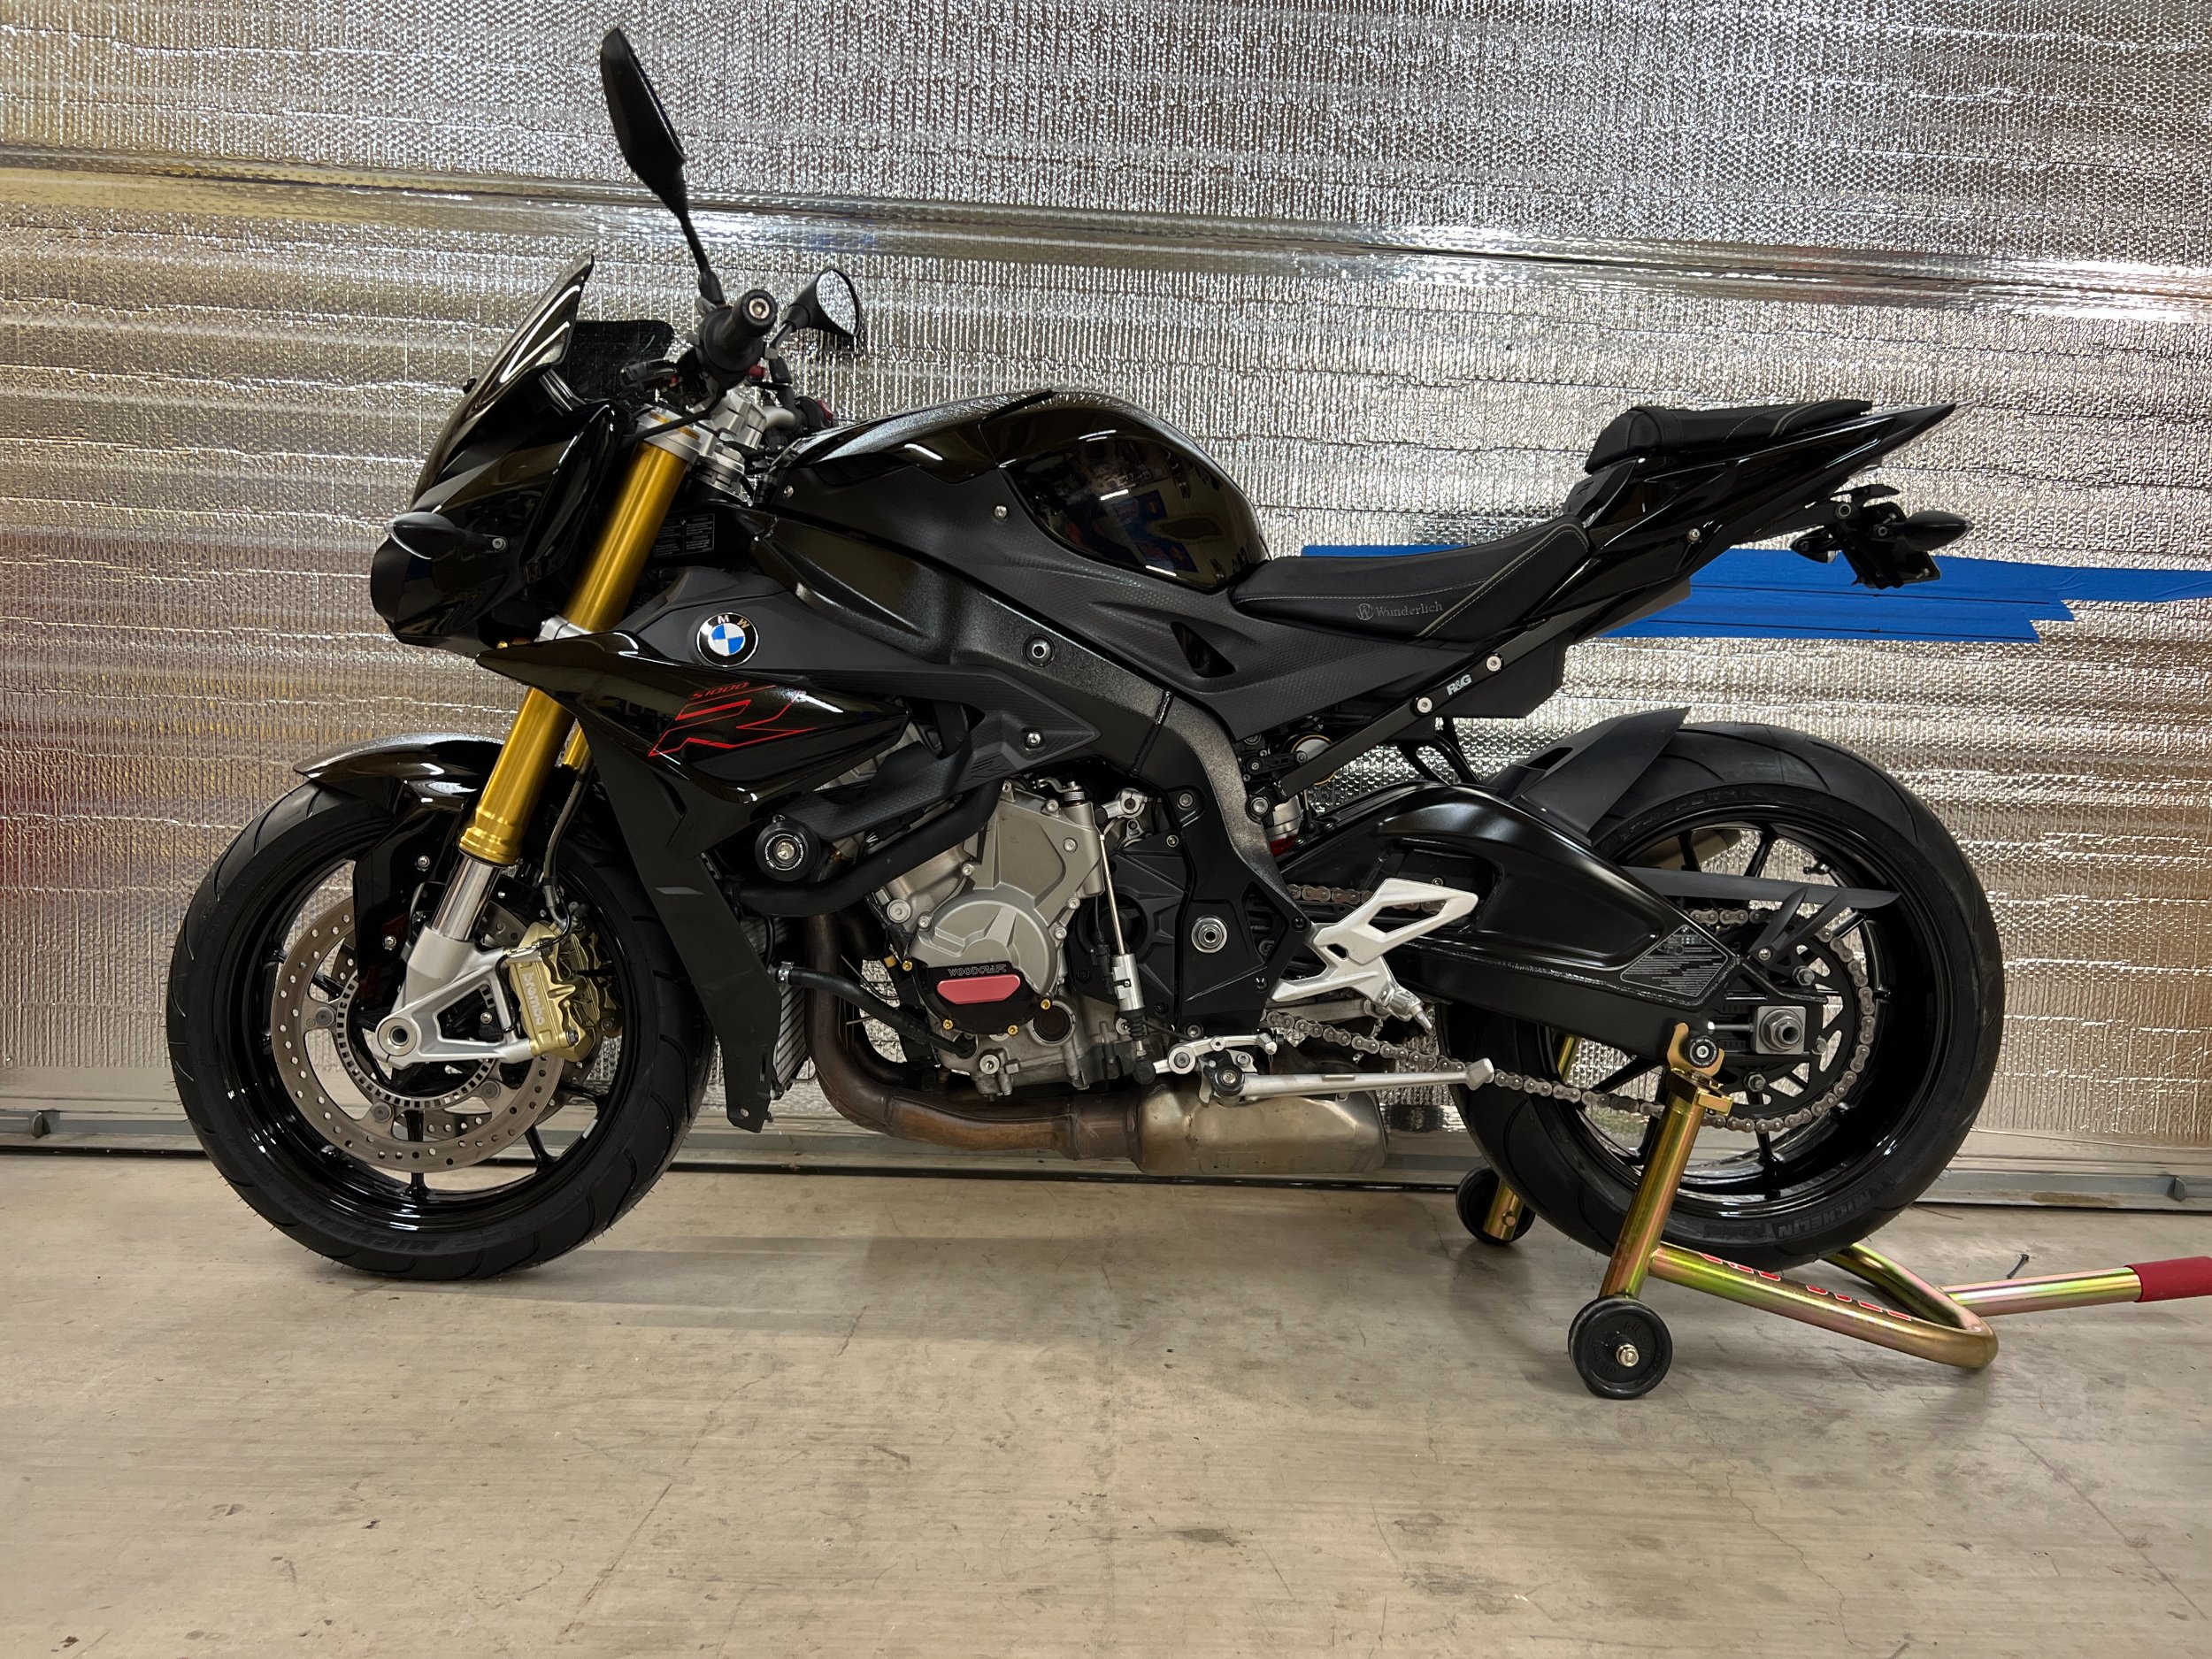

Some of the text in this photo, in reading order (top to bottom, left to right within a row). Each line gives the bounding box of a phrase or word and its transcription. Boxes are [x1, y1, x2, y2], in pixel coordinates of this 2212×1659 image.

[1375, 601, 1443, 618] Wunderlich
[691, 680, 749, 699] S1000
[1446, 674, 1472, 695] R&G
[948, 964, 1007, 977] WOODCRAFT
[522, 972, 545, 1026] brembo
[1778, 1189, 1871, 1239] MICHELIN
